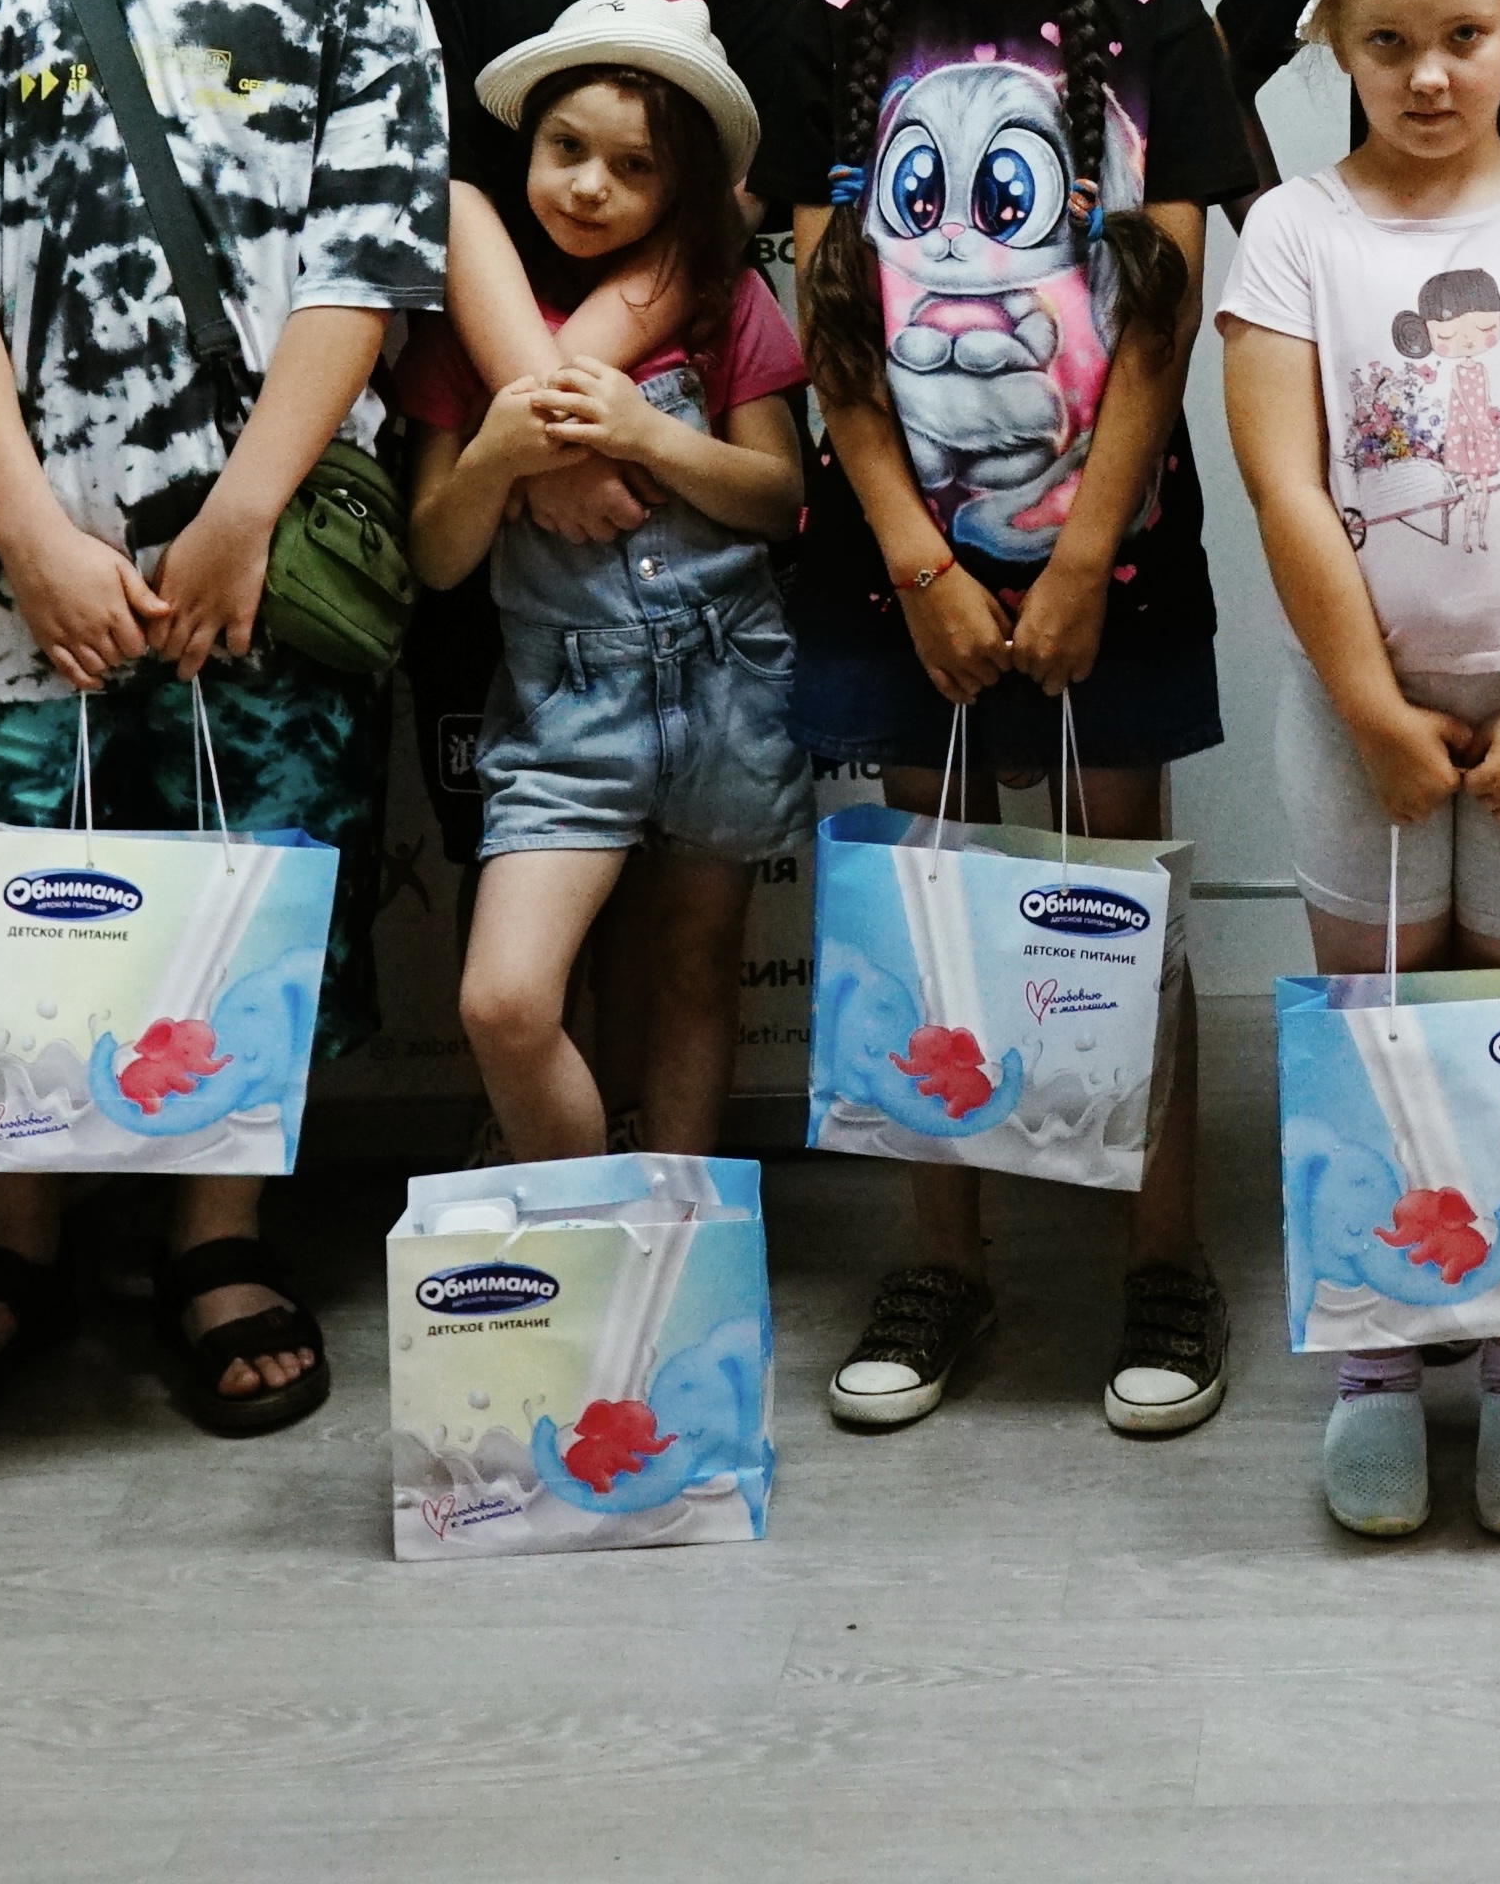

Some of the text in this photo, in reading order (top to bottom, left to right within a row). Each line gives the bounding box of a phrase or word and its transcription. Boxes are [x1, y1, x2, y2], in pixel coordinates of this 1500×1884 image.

[69, 64, 87, 79] 19
[5, 877, 140, 910] Обнимама
[1022, 891, 1146, 930] Обнимама
[7, 925, 129, 942] ДЕТСКОЕ ПИТАНИЕ
[1023, 944, 1137, 966] ДЕТСКОЕ ПИТАНИЕ
[418, 1275, 556, 1306] Обнимама
[426, 1317, 551, 1337] ДЕТСКОЕ ПИТАНИЕ
